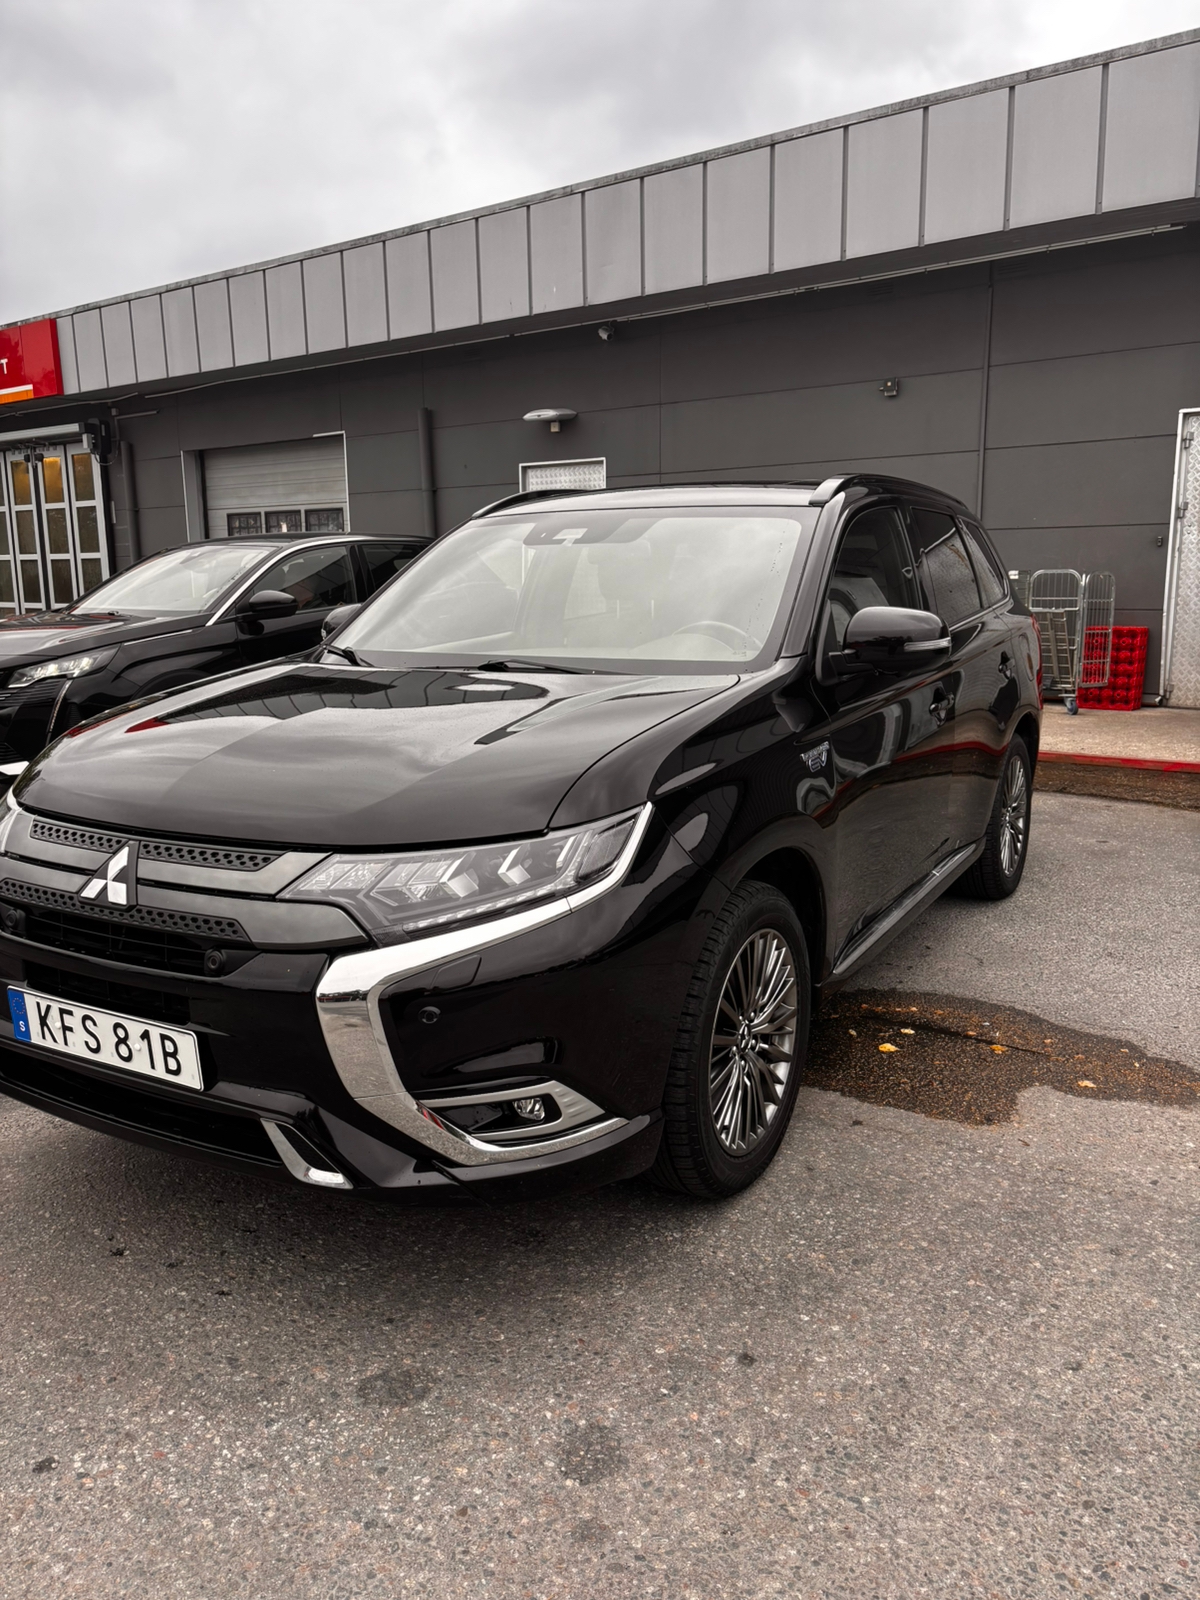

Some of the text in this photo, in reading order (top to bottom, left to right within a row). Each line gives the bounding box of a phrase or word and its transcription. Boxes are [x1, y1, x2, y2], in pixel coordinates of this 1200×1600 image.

[19, 1020, 26, 1032] S
[36, 1000, 181, 1076] KFS 81B
